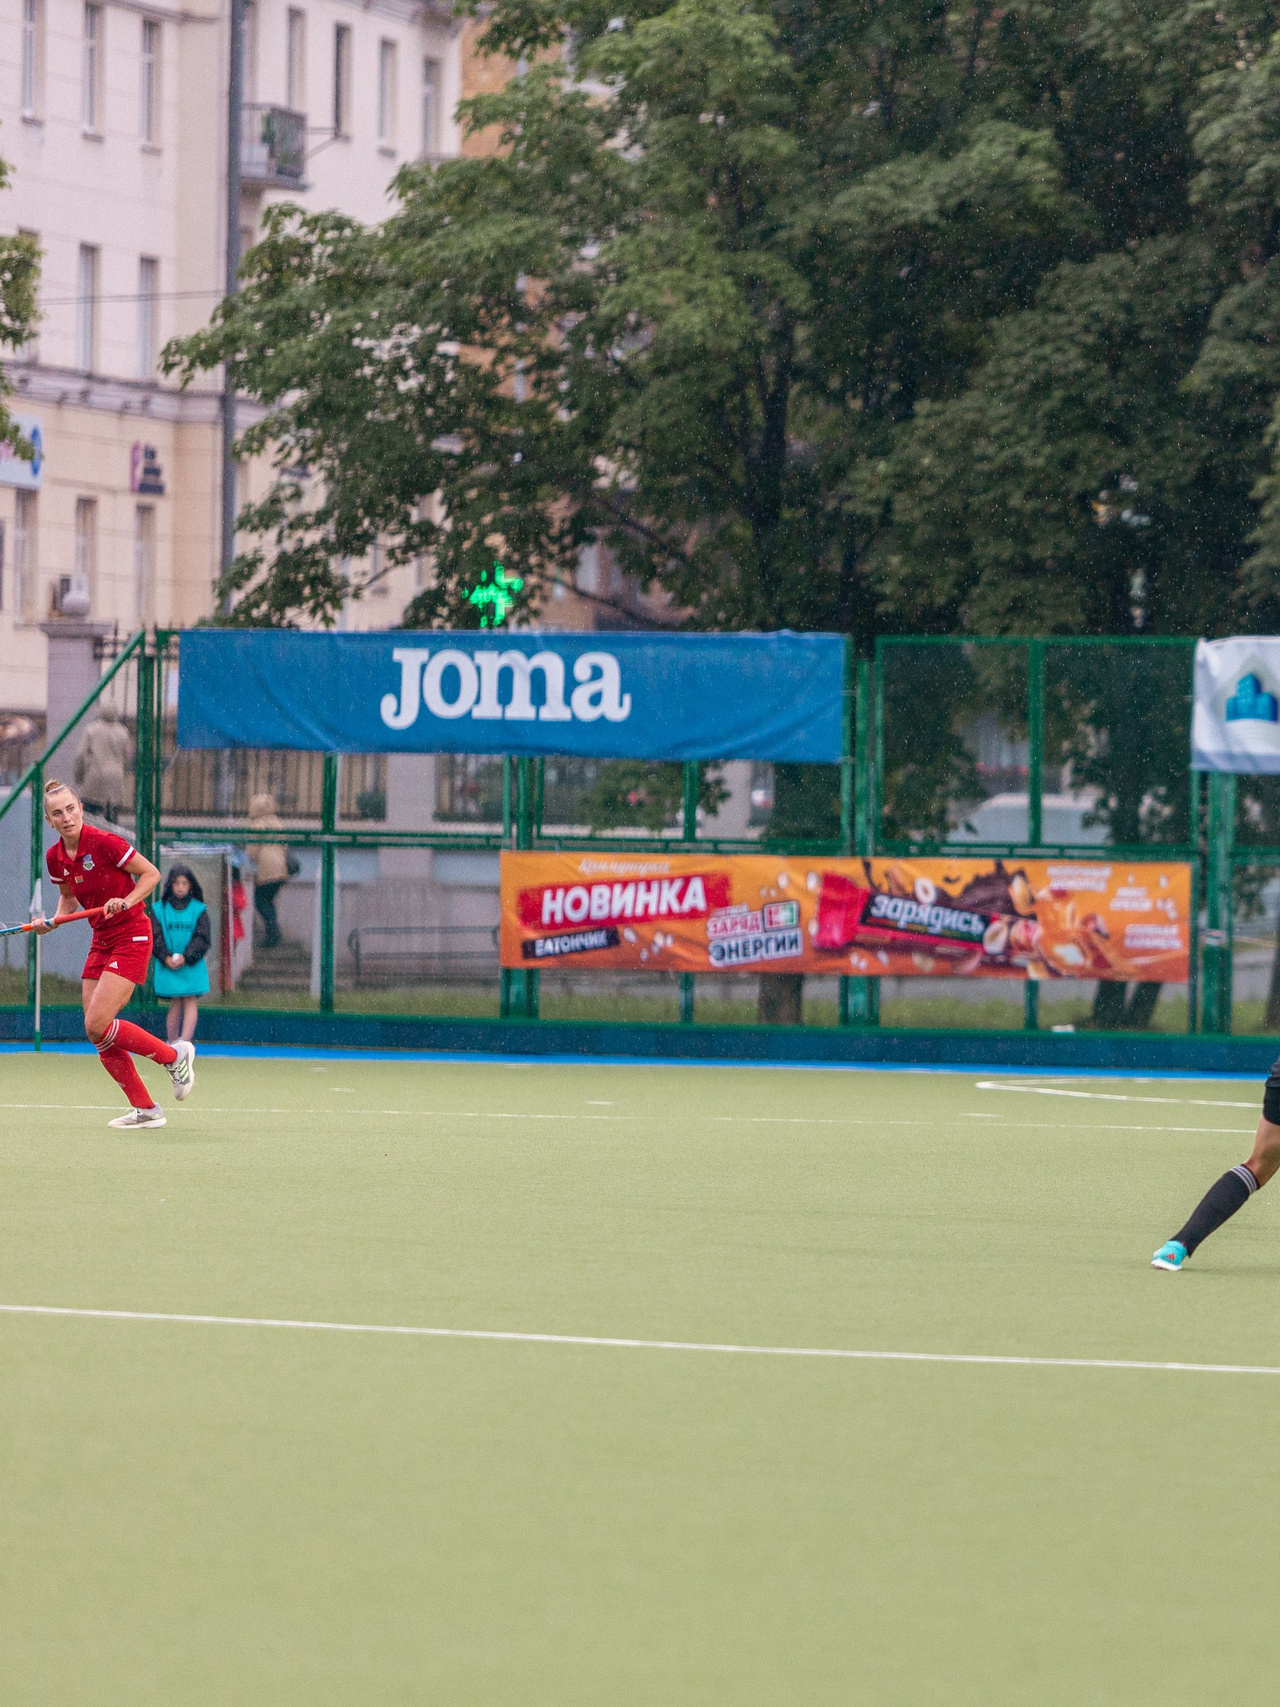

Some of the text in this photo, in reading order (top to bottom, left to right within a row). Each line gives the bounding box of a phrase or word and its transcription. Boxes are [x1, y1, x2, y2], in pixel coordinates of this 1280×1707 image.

[541, 876, 708, 926] НОВИНКА
[710, 912, 762, 936] ЗАРЯД
[711, 933, 801, 962] ЭНЕРГИИ
